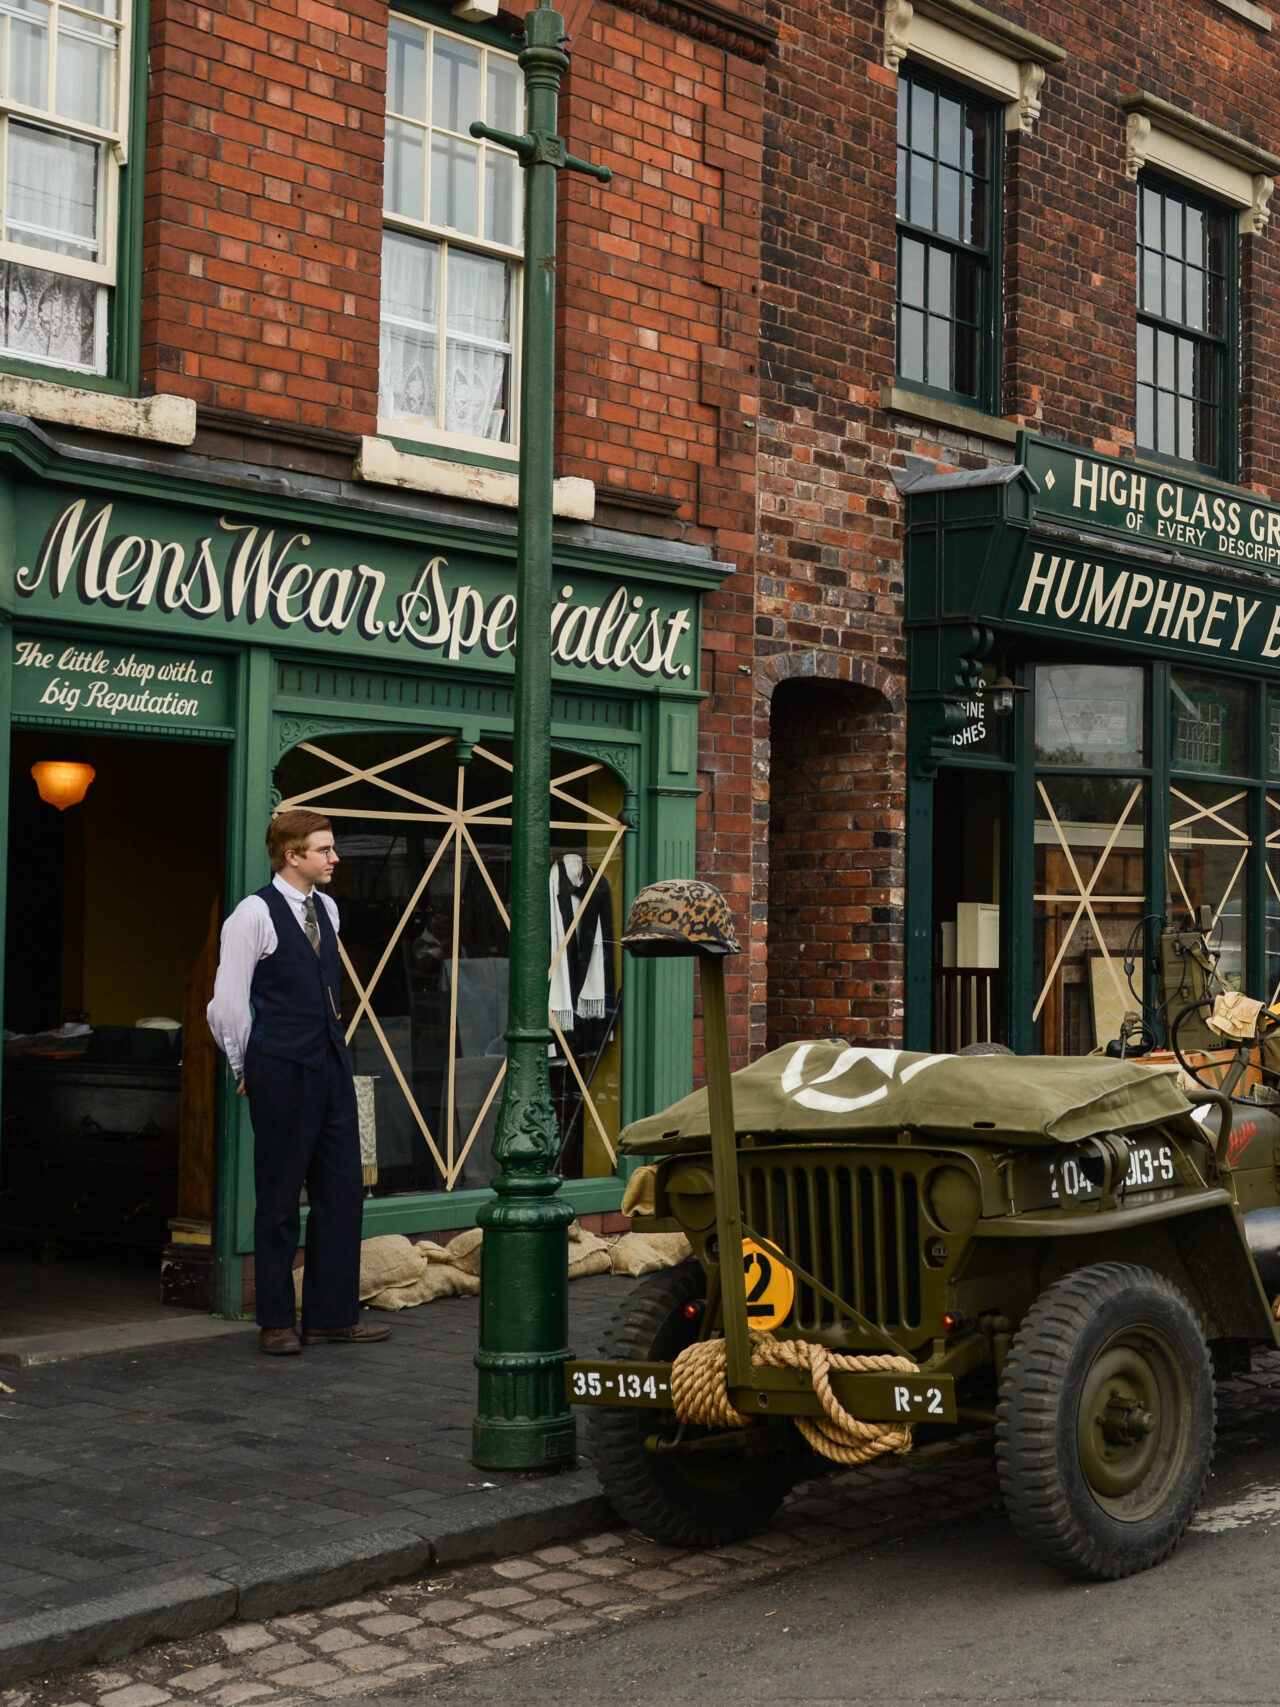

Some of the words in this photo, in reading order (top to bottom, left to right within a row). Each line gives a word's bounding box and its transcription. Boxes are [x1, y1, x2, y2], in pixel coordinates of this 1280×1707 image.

[1073, 458, 1147, 512] HIGH
[1156, 482, 1241, 535] CLASS
[1126, 512, 1145, 531] OF
[1157, 519, 1207, 546] EVERY
[16, 498, 222, 613] Mens
[219, 514, 386, 635] Wear
[388, 556, 691, 676] Speialist.
[1018, 552, 1261, 651] HUMPHREY
[13, 642, 55, 668] The
[56, 646, 110, 674] little
[112, 653, 155, 687] shop
[157, 660, 199, 684] with
[200, 668, 214, 685] a
[40, 677, 82, 712] big
[80, 681, 200, 717] Reputation
[957, 701, 985, 718] INE
[893, 1386, 944, 1414] R-2
